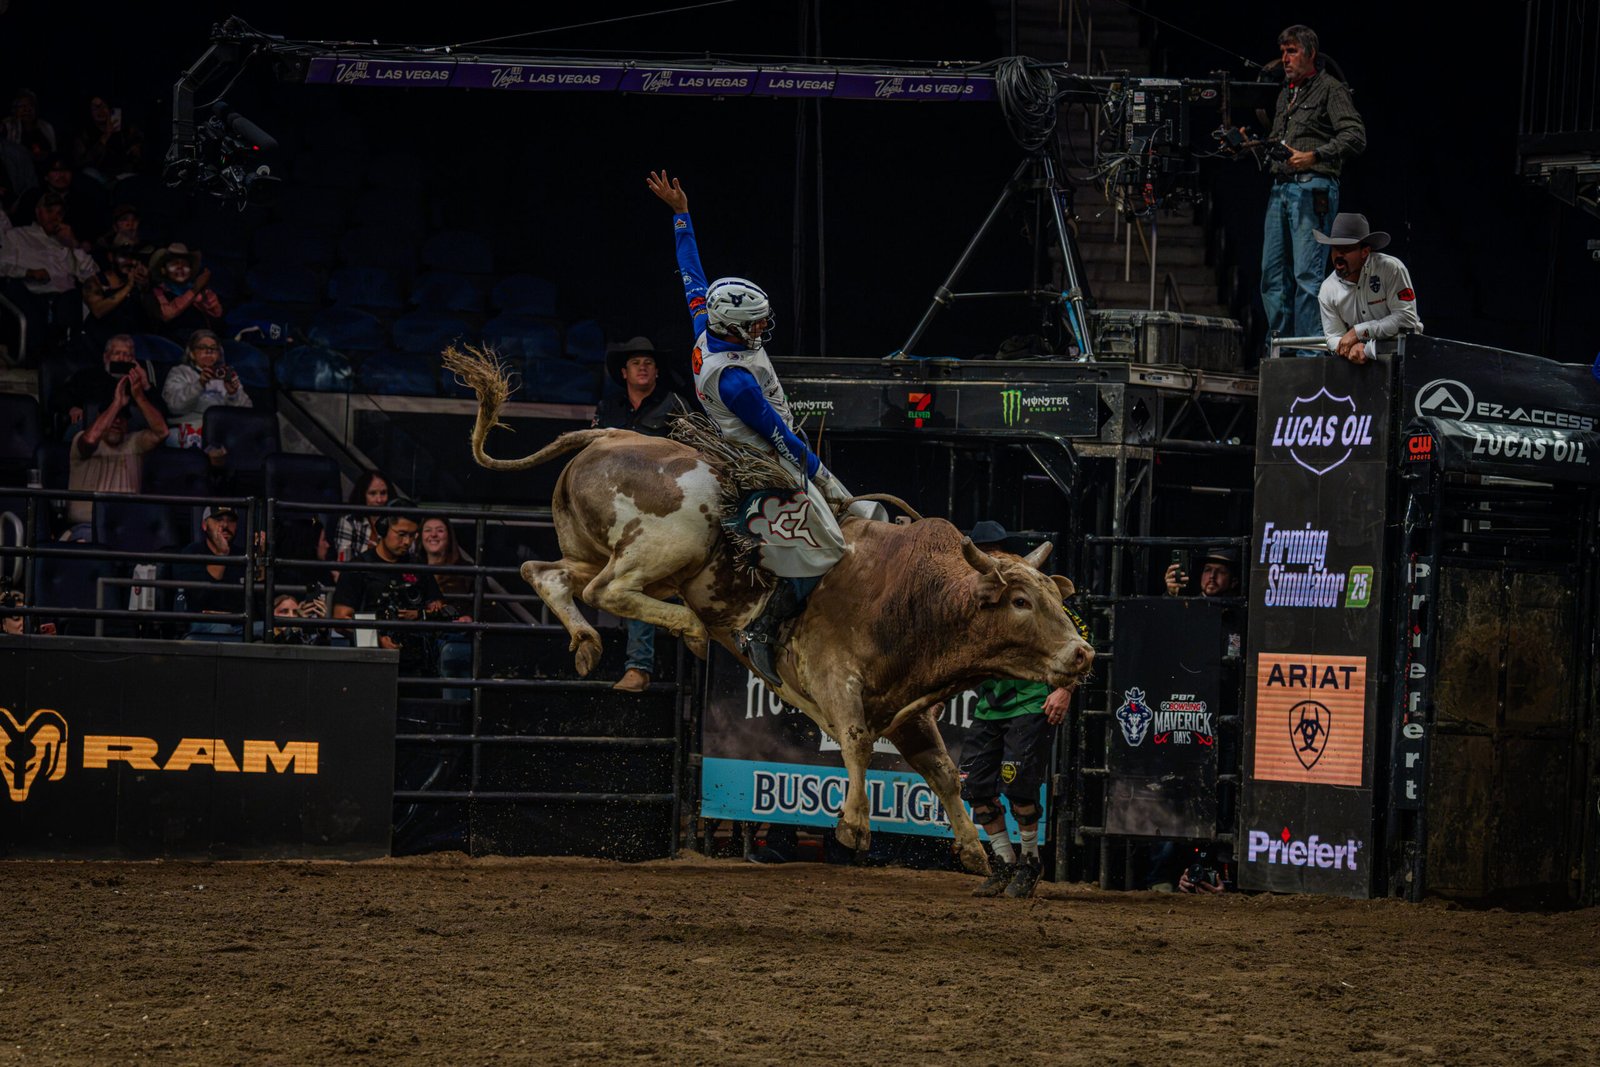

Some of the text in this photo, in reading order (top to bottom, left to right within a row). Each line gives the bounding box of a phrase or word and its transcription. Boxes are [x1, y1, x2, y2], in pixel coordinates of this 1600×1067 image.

[336, 63, 370, 83] Vegas
[375, 69, 402, 80] LAS
[405, 70, 449, 81] VEGAS
[491, 68, 524, 88] Vegas
[529, 73, 555, 83] LAS
[558, 74, 601, 84] VEGAS
[641, 72, 674, 92] Vegas
[678, 77, 704, 87] LAS
[707, 78, 748, 88] VEGAS
[769, 78, 835, 90] LAS VEGAS
[908, 83, 932, 93] LAS
[934, 84, 974, 94] VEGAS
[788, 400, 834, 410] MONSTER
[1022, 396, 1070, 406] MONSTER
[1271, 414, 1373, 447] LUCAS OIL
[770, 425, 801, 469] Wrangle
[1408, 435, 1432, 454] CW
[1472, 432, 1588, 464] LUCAS OIL
[1259, 521, 1329, 572] Farming
[1264, 563, 1346, 608] Simulator
[1350, 573, 1369, 600] 25
[1266, 663, 1357, 690] ARIAT
[1403, 562, 1432, 800] Priefert
[1170, 693, 1196, 701] PBR
[1154, 711, 1213, 737] MAVERICK
[1173, 731, 1192, 745] DAYS
[83, 734, 320, 775] RAM
[752, 770, 849, 818] BUSC
[1246, 827, 1358, 871] Priefert
